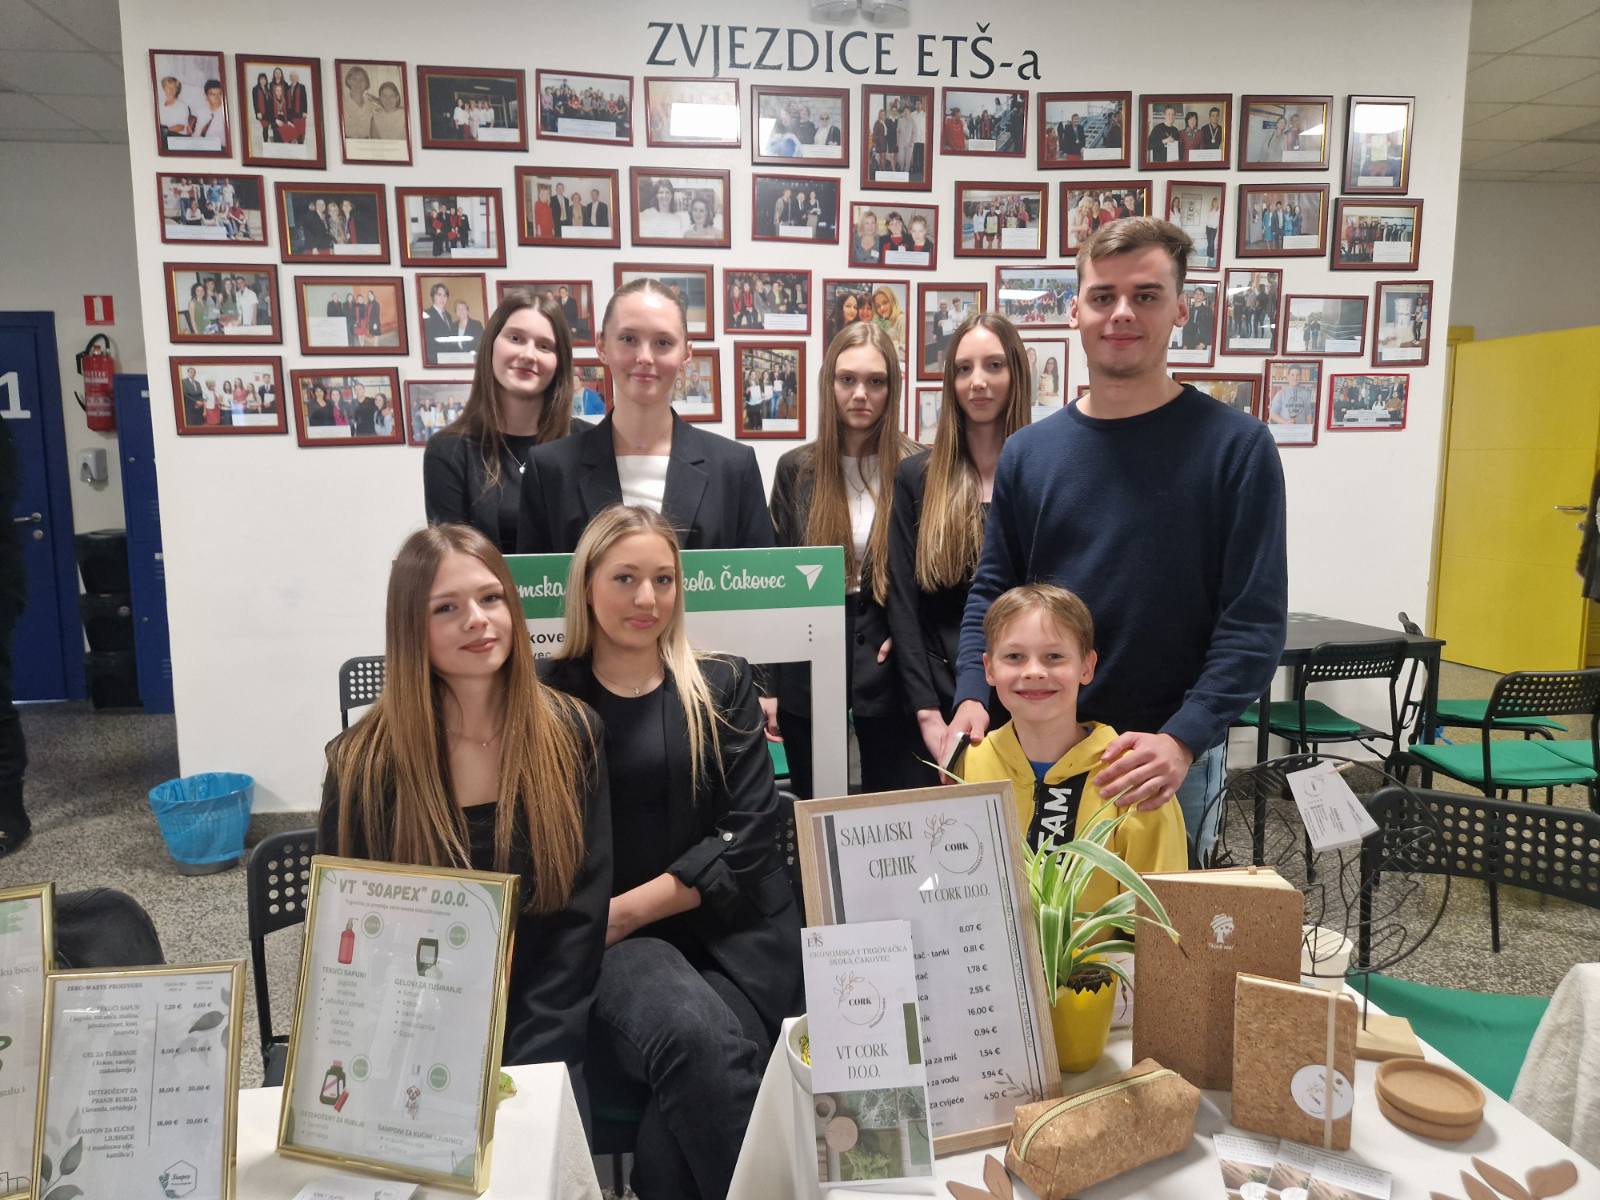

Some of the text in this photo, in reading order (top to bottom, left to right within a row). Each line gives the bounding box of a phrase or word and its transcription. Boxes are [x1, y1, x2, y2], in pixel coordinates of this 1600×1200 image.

[646, 22, 1042, 80] ZVJEZDICE ETŠ-a
[0, 371, 31, 419] 1
[516, 564, 786, 598] mska kola Čakovec
[530, 632, 566, 644] kove
[840, 821, 913, 847] SAJAMSKI
[944, 841, 969, 852] CORK
[869, 855, 918, 880] CJENIK
[338, 877, 357, 894] VT
[431, 889, 469, 907] D.O.O.
[919, 883, 991, 904] VT CORK D.O.O.
[979, 943, 985, 951] €
[913, 951, 926, 960] tač
[931, 948, 950, 958] tanki
[982, 963, 988, 971] €
[985, 984, 991, 992] €
[848, 996, 872, 1007] CORK
[988, 1005, 995, 1013] €
[992, 1026, 998, 1034] €
[836, 1043, 889, 1060] VT CORK
[995, 1047, 1001, 1055] €
[848, 1063, 881, 1080] D.O.O.
[941, 1075, 959, 1084] vodu
